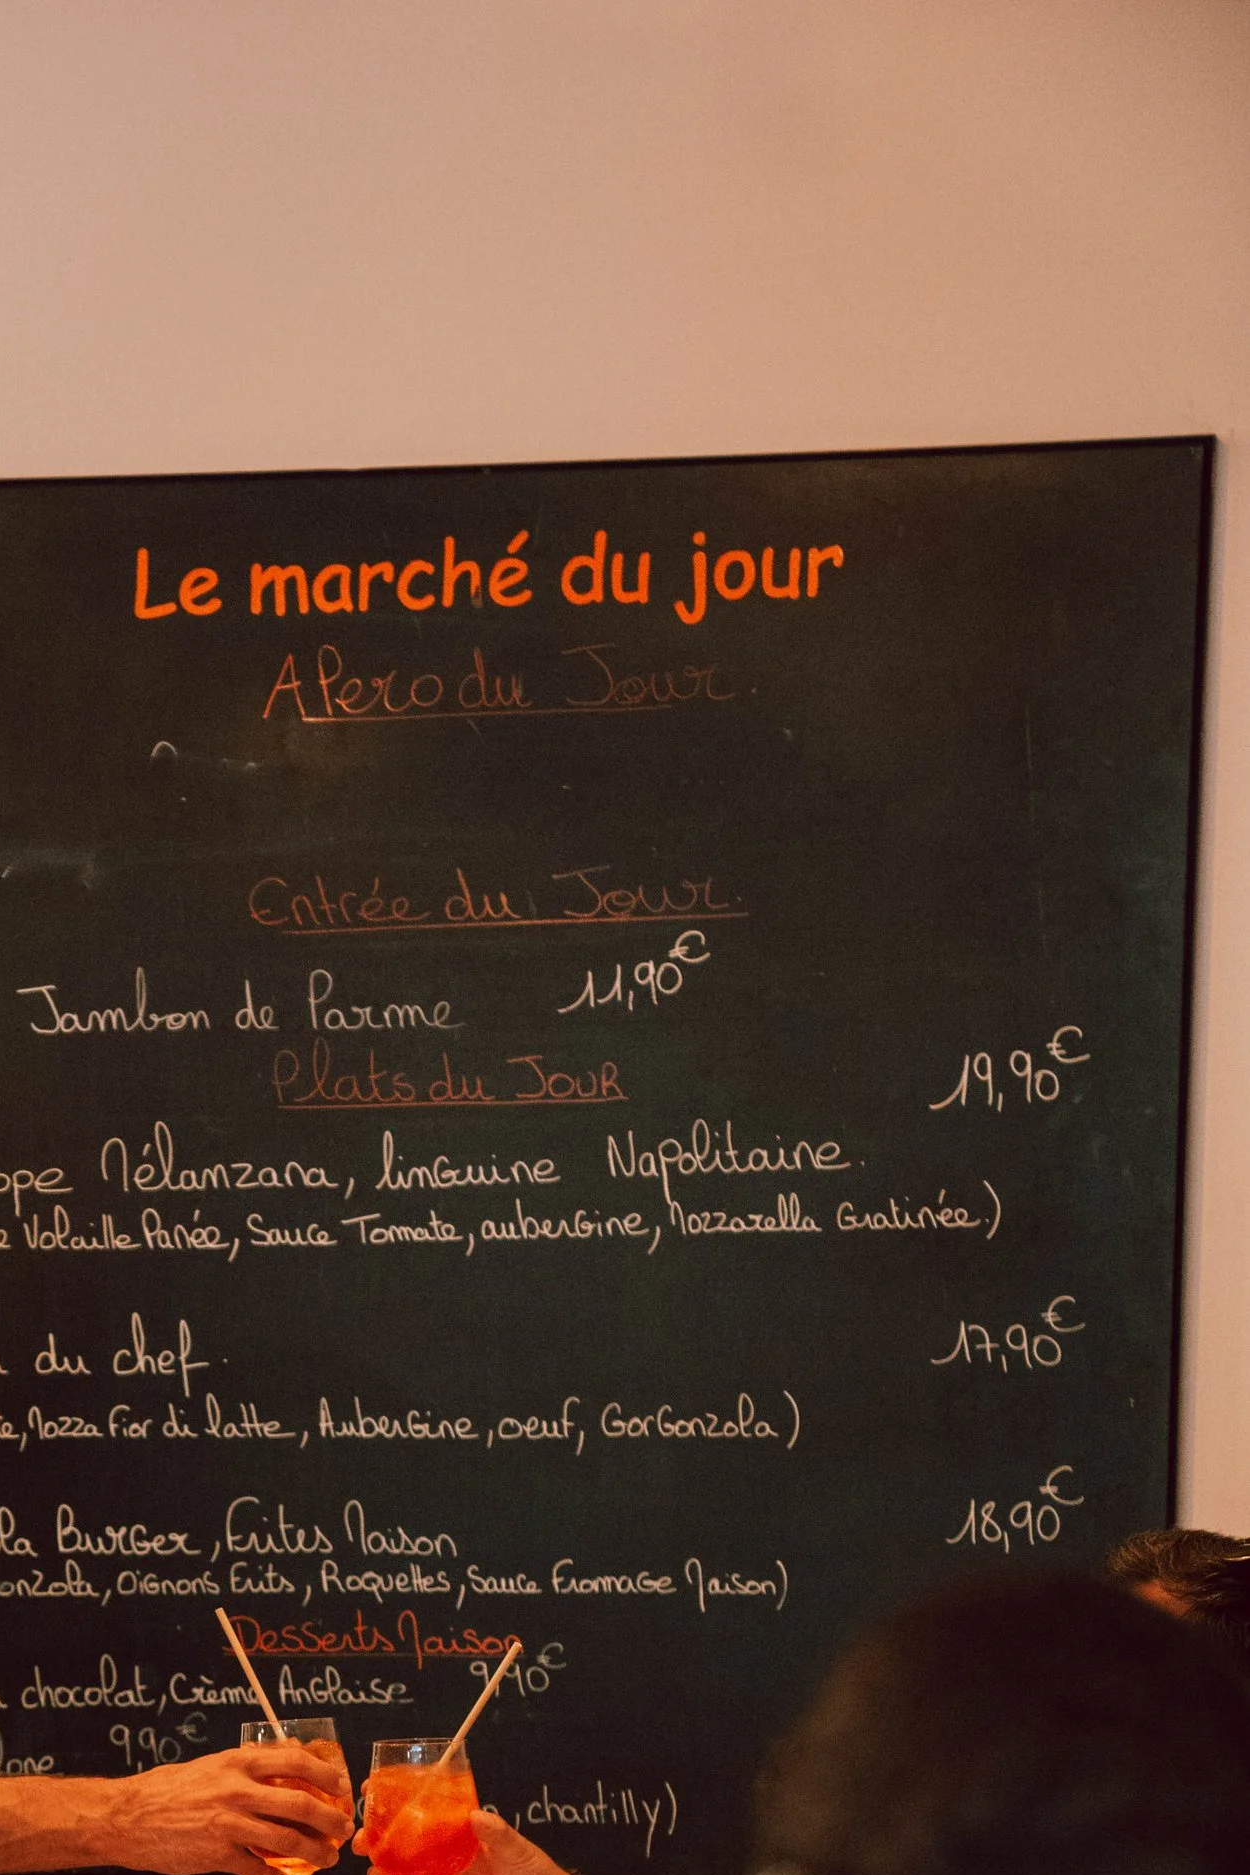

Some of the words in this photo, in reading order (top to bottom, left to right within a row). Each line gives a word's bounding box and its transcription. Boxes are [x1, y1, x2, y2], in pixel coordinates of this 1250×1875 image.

[134, 547, 221, 618] Le
[249, 530, 533, 617] marché
[560, 529, 650, 605] du
[674, 531, 845, 625] jour
[458, 647, 530, 708] du
[561, 642, 736, 705] Jour
[250, 876, 431, 928] Entrée
[444, 867, 522, 921] du
[16, 966, 210, 1034] Jambon
[234, 979, 280, 1029] de
[308, 968, 465, 1031] Parme
[558, 929, 711, 1014] 11,90€
[272, 1036, 415, 1103] Plats
[429, 1051, 496, 1100] du
[929, 1024, 1091, 1112] 19,90€
[23, 1204, 141, 1251] Volaille
[141, 1207, 240, 1264] Panée,
[246, 1213, 338, 1247] Sauce
[34, 1333, 92, 1376] du
[931, 1294, 1086, 1374] 17,90€
[161, 1403, 199, 1439] di
[946, 1464, 1085, 1554] 18,90€
[466, 1564, 542, 1596] Sauce
[20, 1653, 168, 1717] chocolat,
